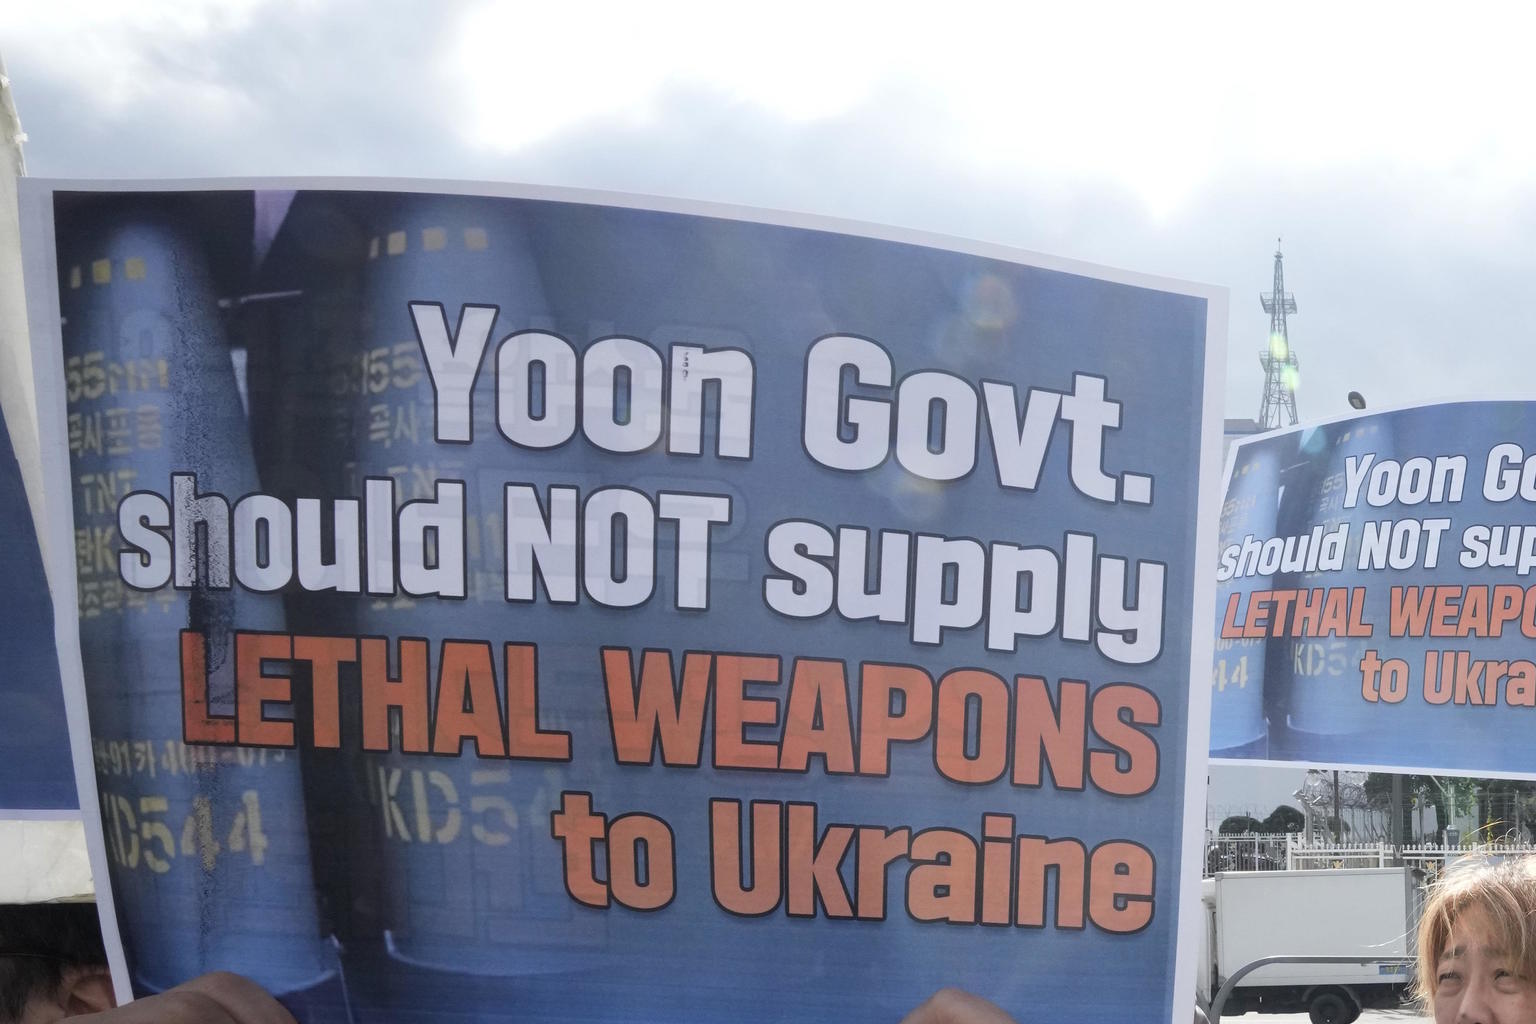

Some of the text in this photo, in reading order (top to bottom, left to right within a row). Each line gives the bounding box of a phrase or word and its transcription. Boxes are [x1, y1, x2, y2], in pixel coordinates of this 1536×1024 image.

[412, 304, 1151, 503] Yoon Govt.
[1343, 452, 1467, 508] Yoon
[120, 474, 1164, 662] should NOT supply
[1217, 523, 1351, 581] should
[1358, 518, 1450, 570] NOT
[1221, 586, 1373, 638] LETHAL
[182, 632, 1158, 793] LETHAL WEAPONS
[1359, 650, 1408, 705] to
[554, 794, 1152, 930] to Ukraine
